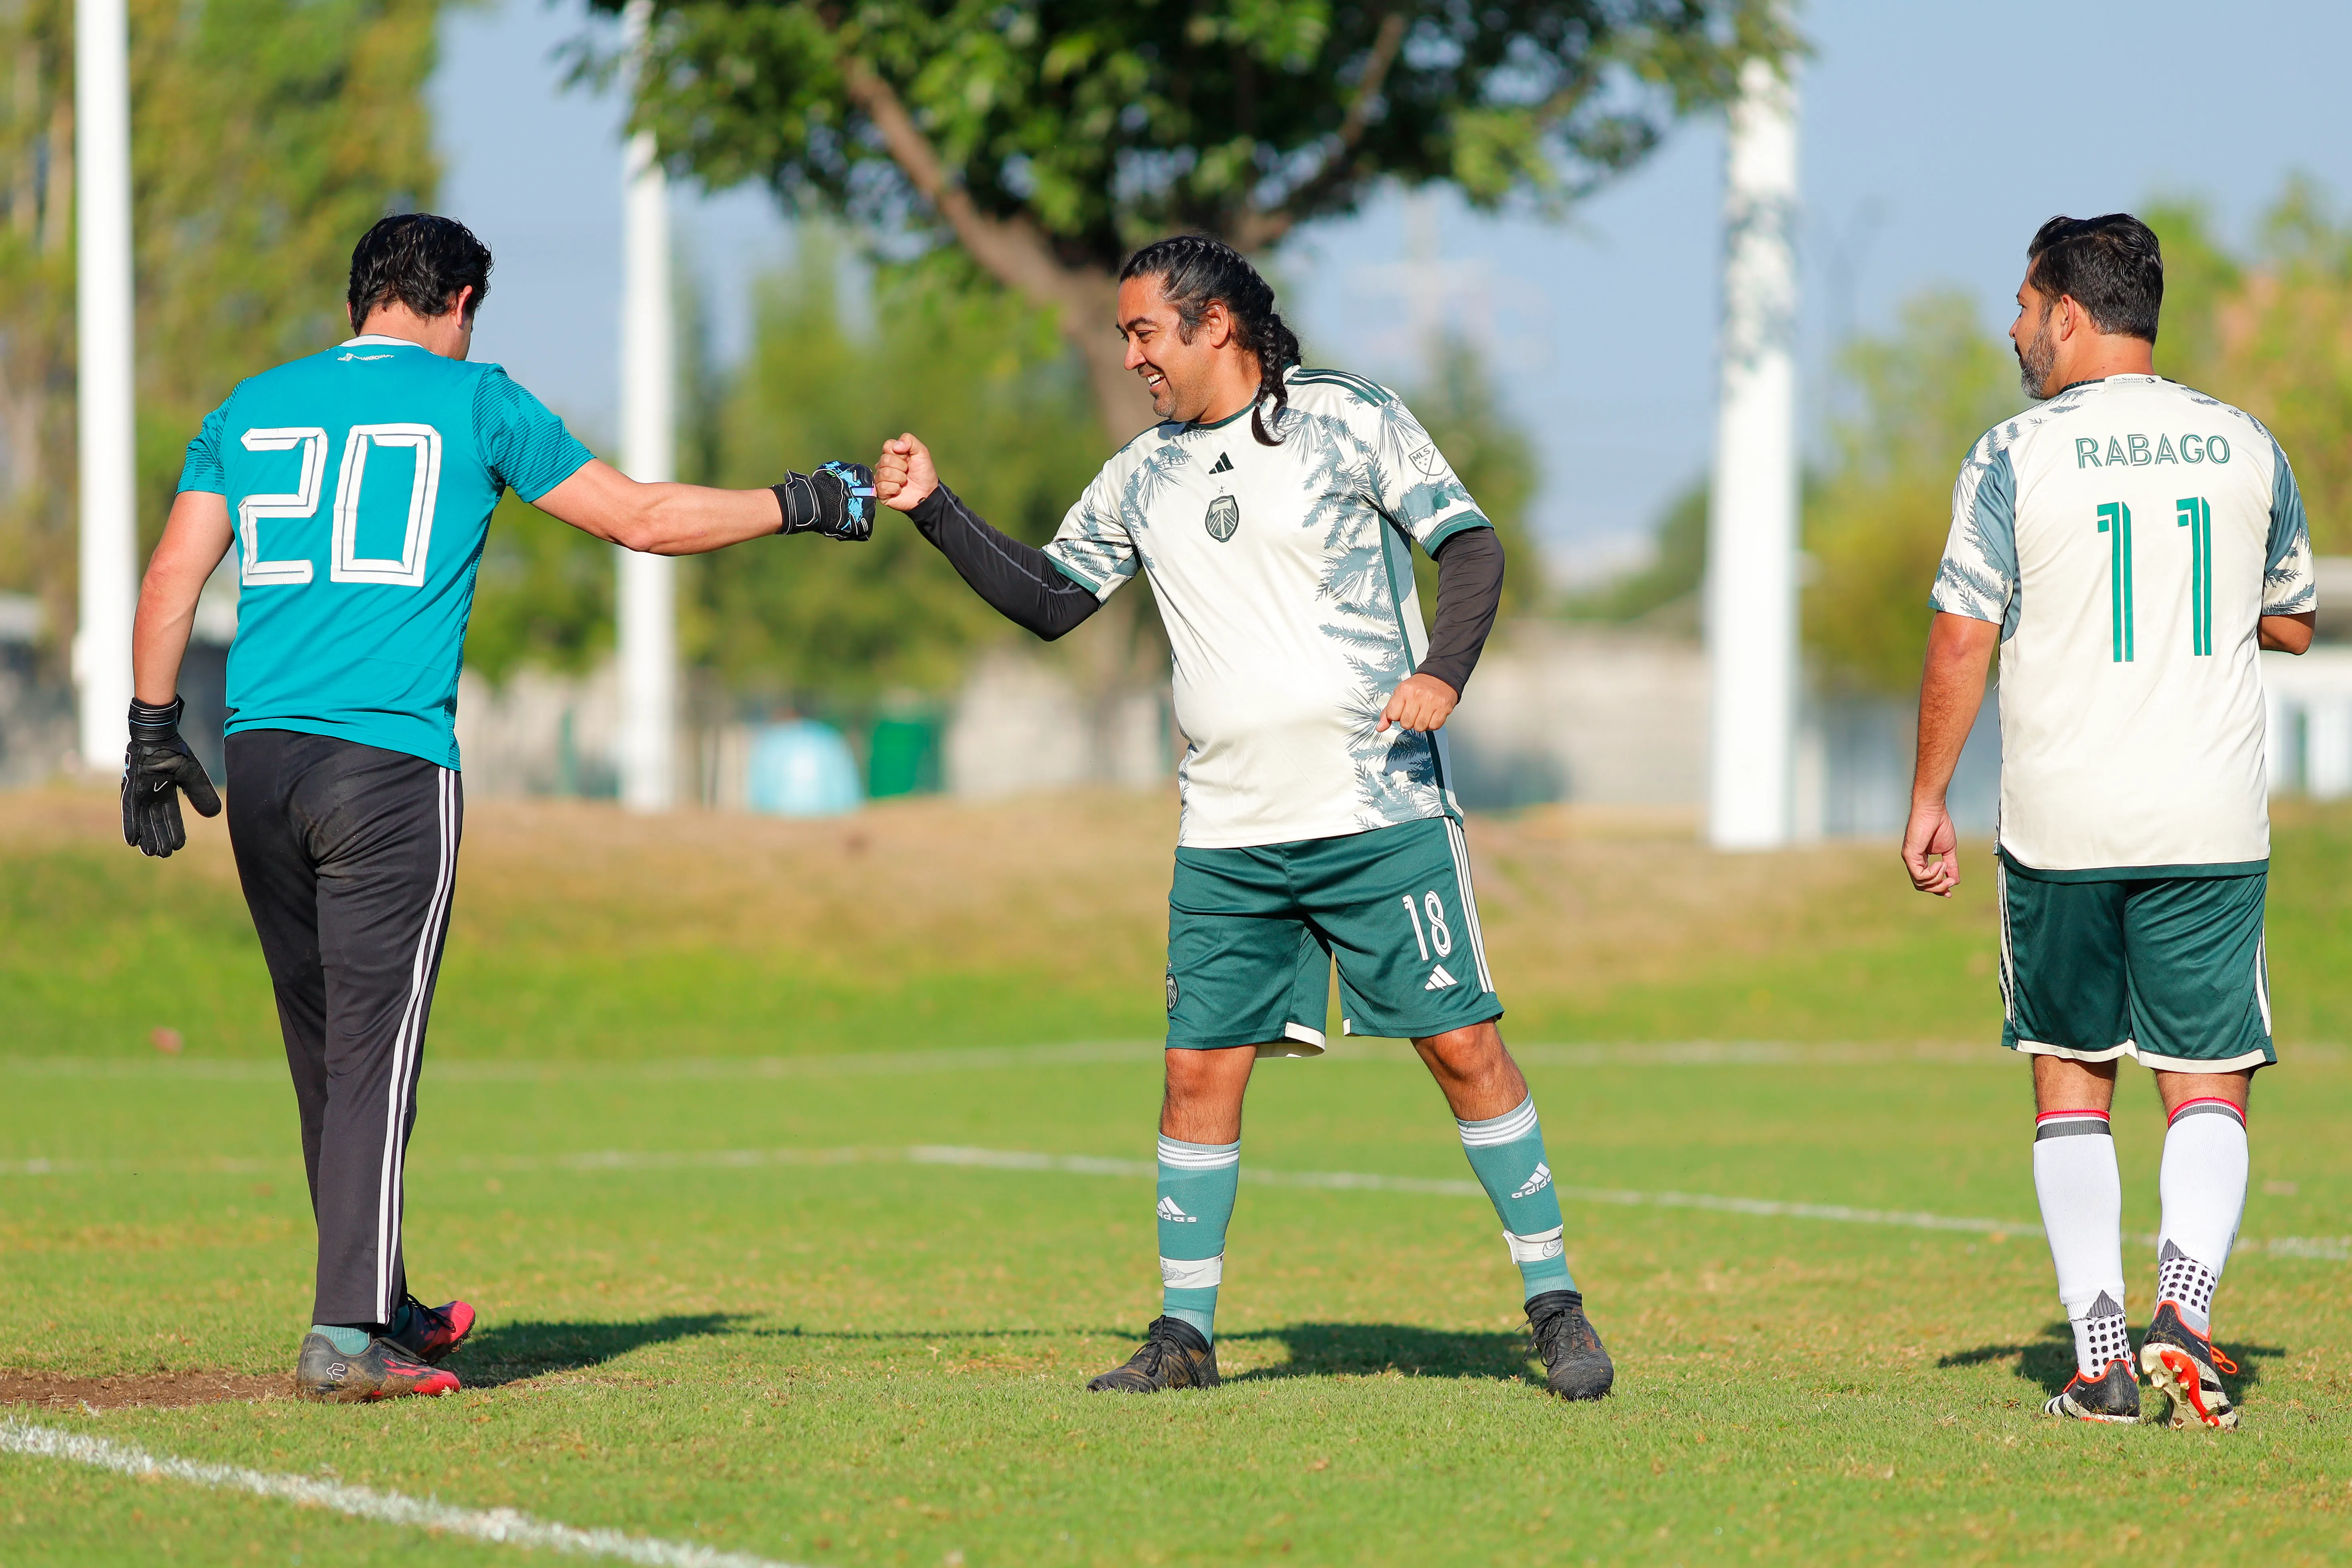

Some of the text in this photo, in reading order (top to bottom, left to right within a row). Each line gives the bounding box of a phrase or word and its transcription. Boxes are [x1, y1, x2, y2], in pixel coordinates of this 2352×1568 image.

[1412, 447, 1431, 462] MLS
[2075, 433, 2231, 469] RABAGO
[238, 422, 443, 587] 20
[2097, 496, 2212, 663] 11
[1402, 890, 1452, 961] 18
[1511, 1173, 1552, 1199] adida
[1156, 1208, 1197, 1223] didas
